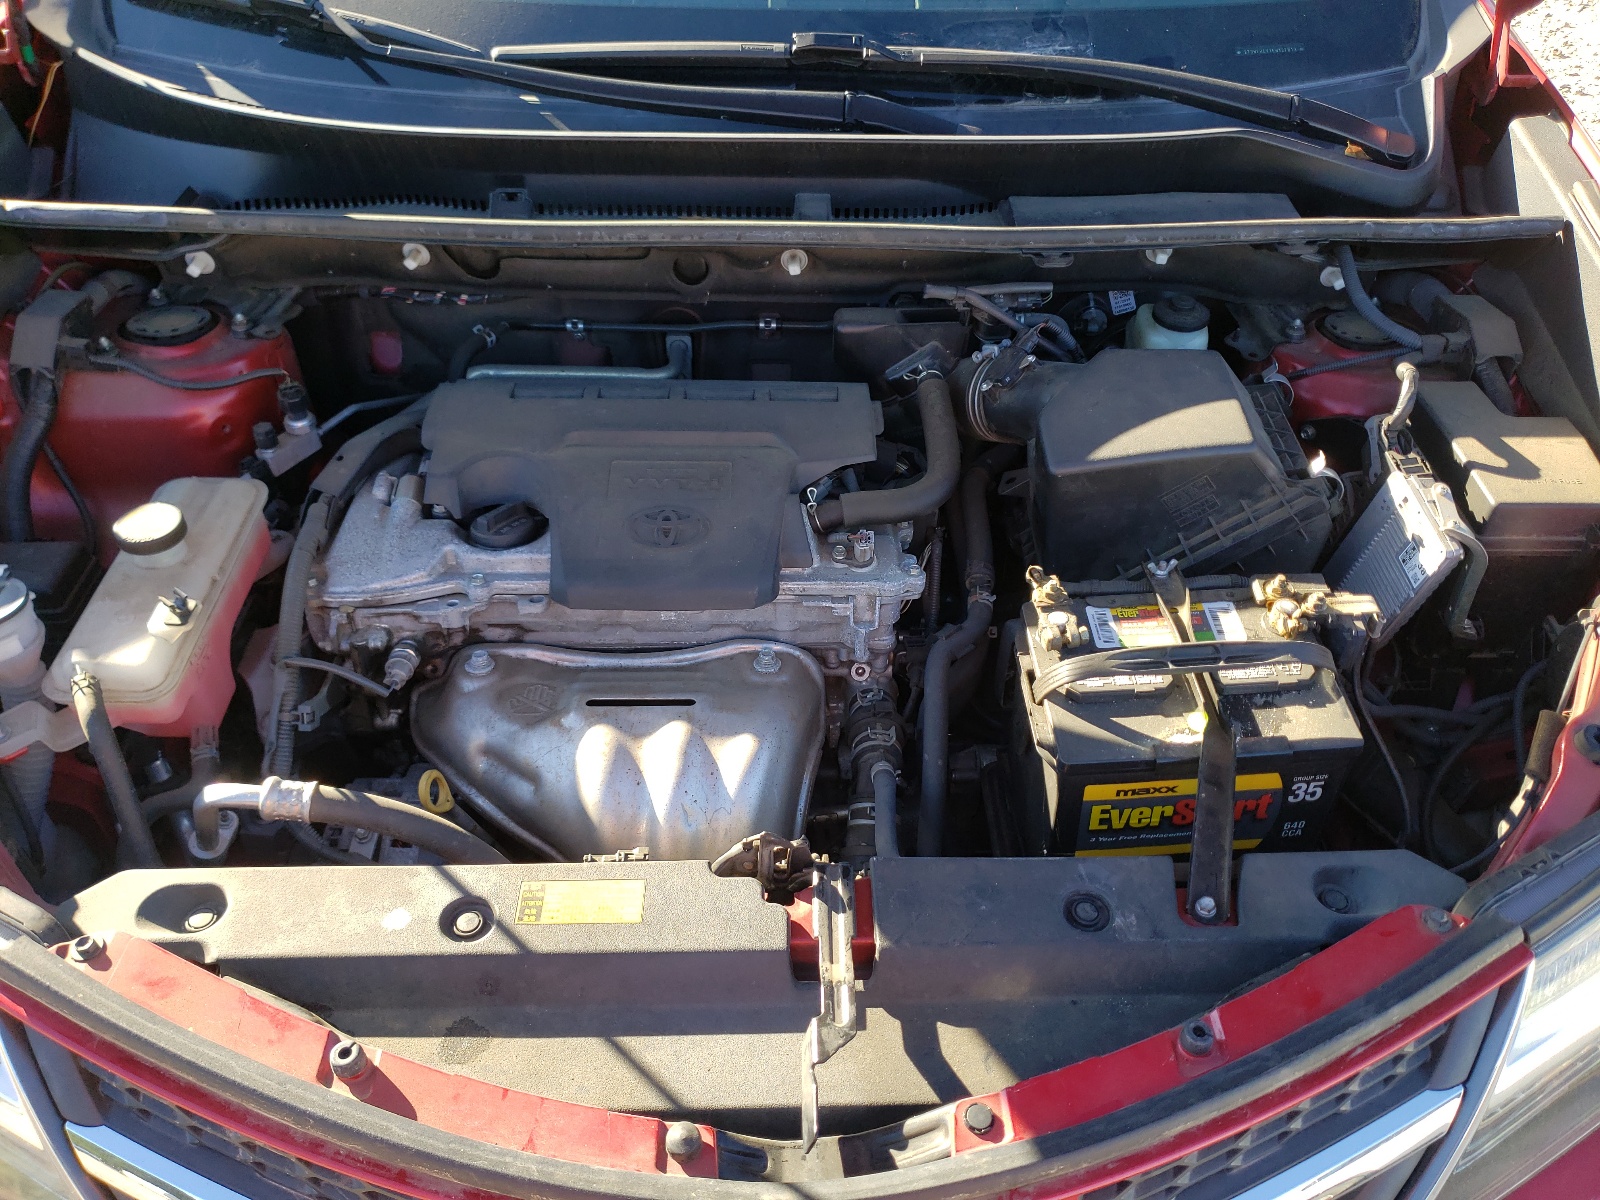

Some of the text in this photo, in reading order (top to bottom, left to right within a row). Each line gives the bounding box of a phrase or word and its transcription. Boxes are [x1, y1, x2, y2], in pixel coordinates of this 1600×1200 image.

[1115, 785, 1179, 798] maxx
[1287, 780, 1325, 803] 35
[1089, 793, 1273, 831] EverSrt
[1283, 820, 1306, 830] 640
[1139, 830, 1193, 840] Replacemen
[1281, 828, 1302, 837] CCA
